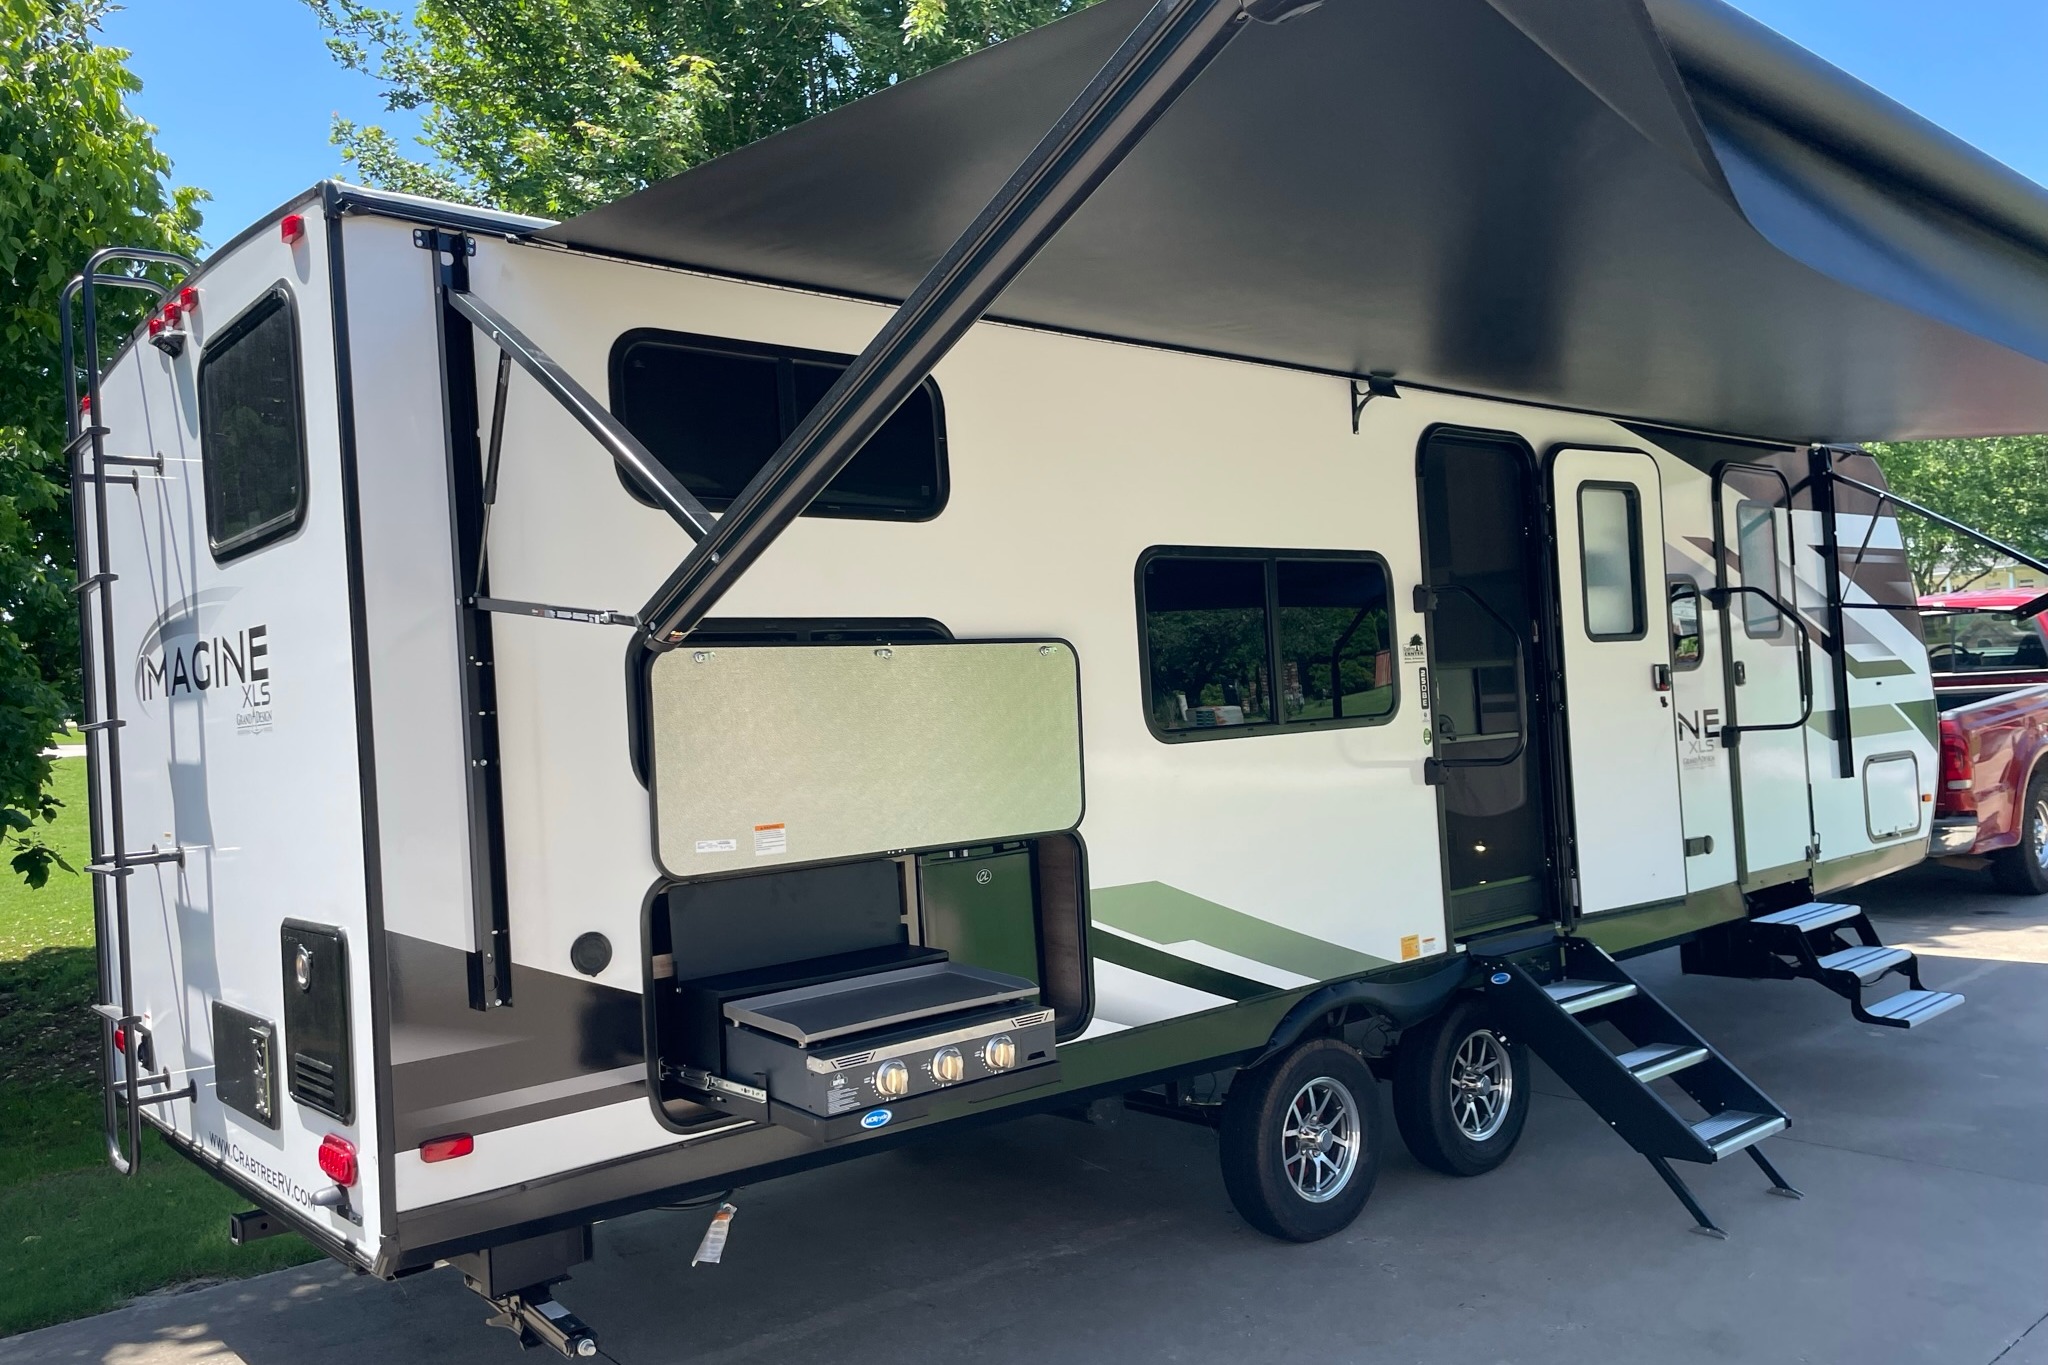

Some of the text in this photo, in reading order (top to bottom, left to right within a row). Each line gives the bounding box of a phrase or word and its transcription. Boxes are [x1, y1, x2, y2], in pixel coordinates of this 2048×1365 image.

[140, 624, 269, 702] IMAGINE
[241, 681, 271, 708] XLS
[1420, 669, 1428, 707] 25DBE
[1688, 739, 1715, 754] XLS
